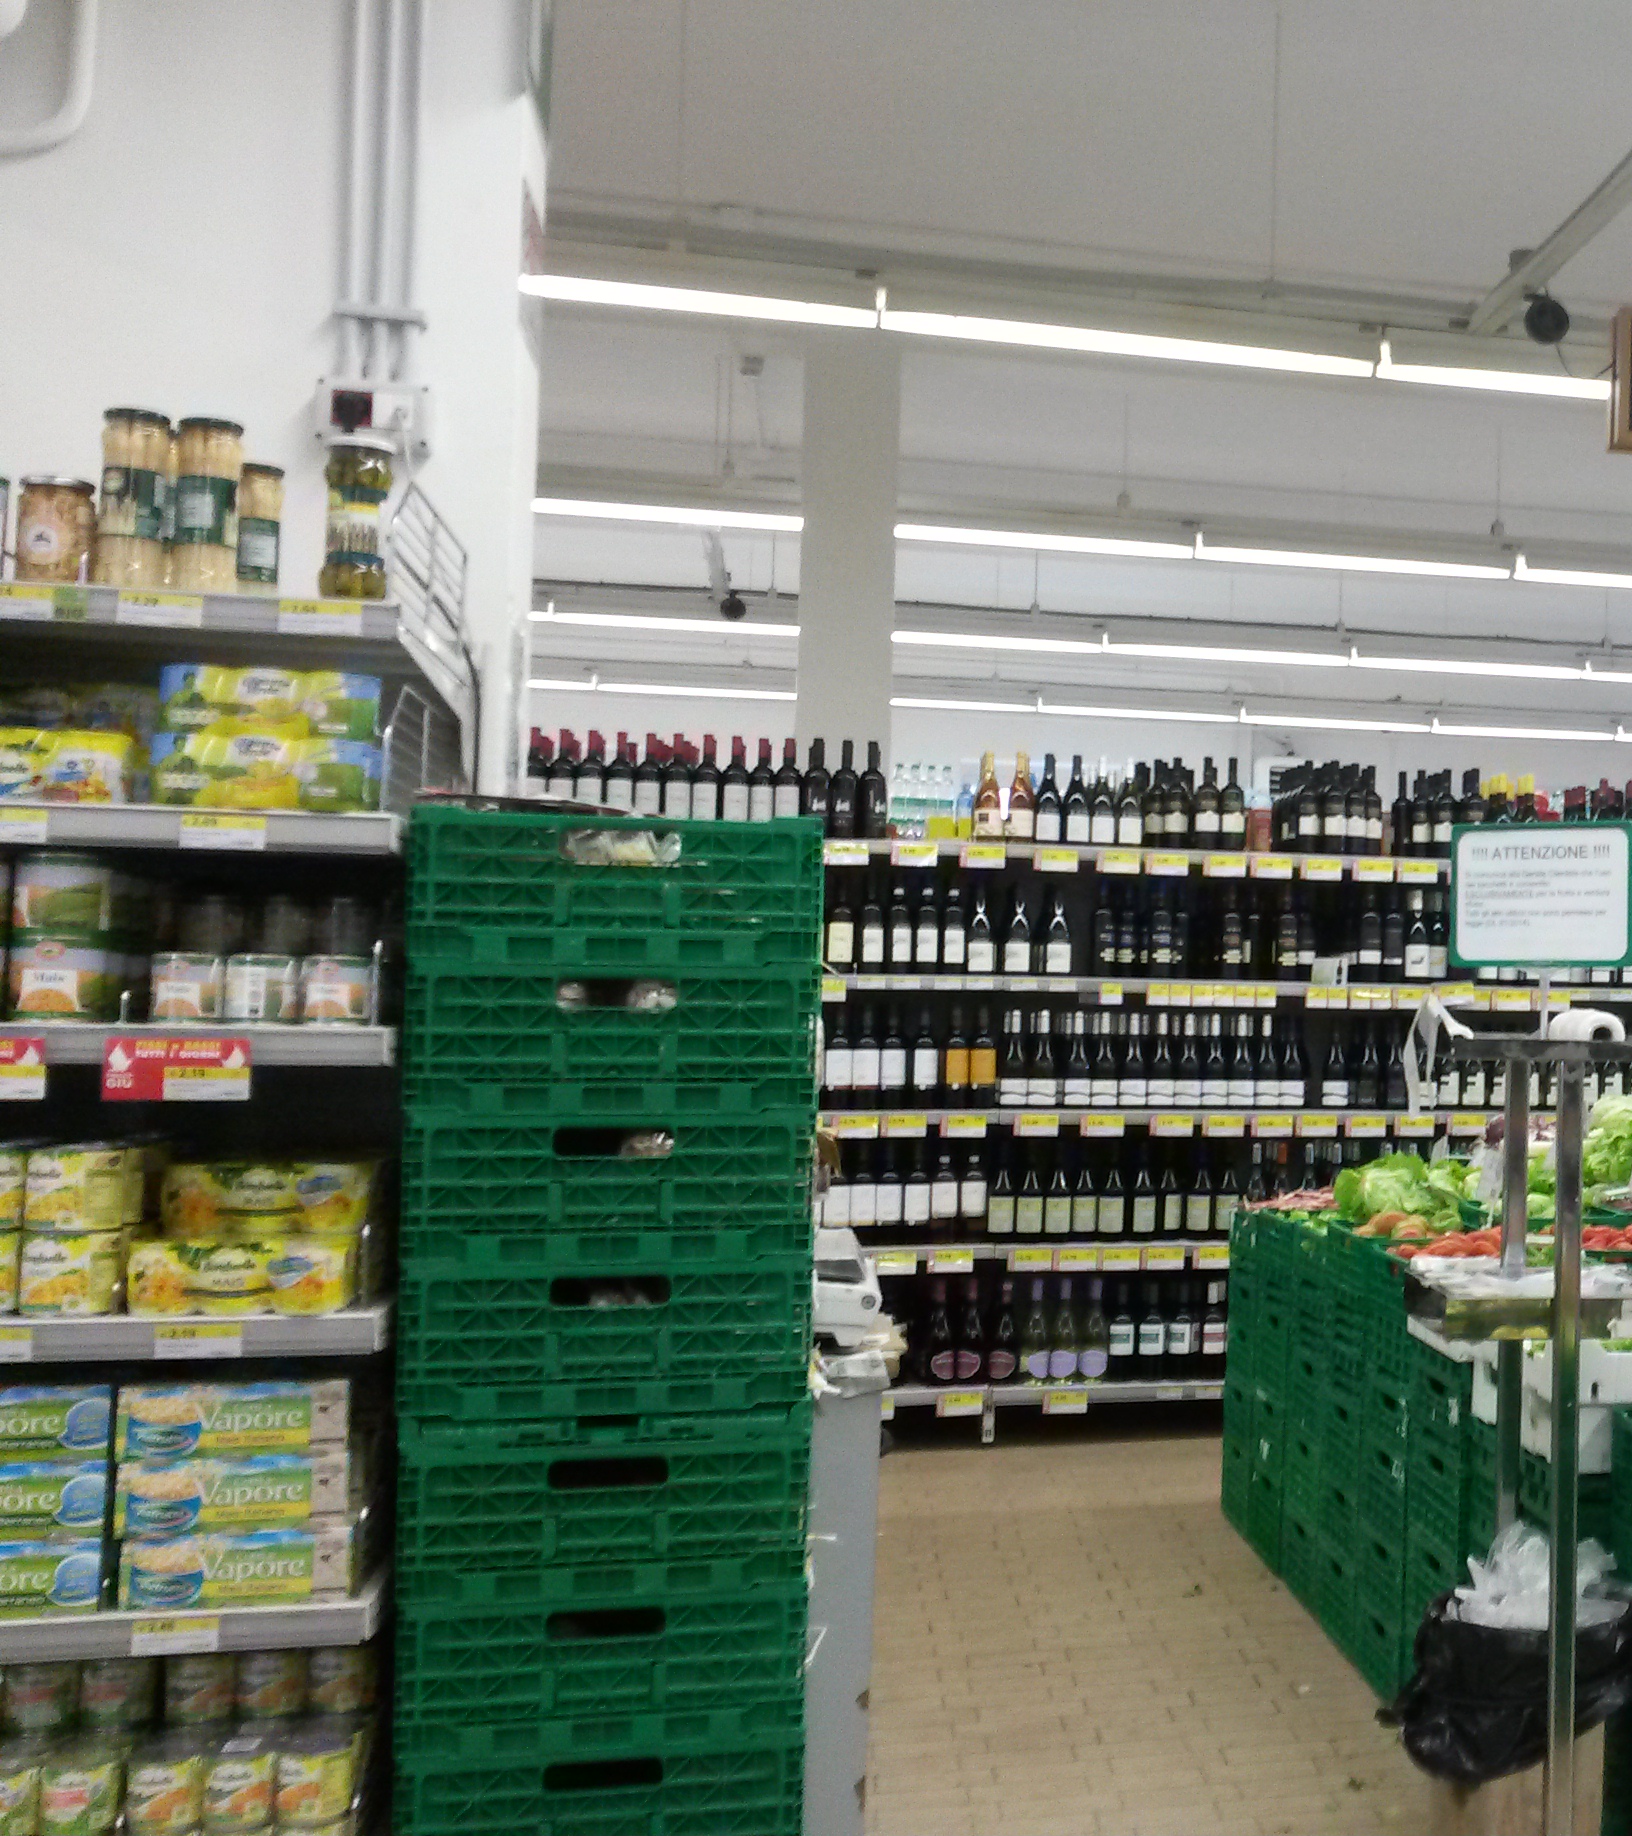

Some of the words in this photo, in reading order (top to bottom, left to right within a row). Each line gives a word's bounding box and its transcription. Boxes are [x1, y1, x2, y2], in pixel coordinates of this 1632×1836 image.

[1491, 845, 1588, 861] ATTENZIONE
[197, 1402, 304, 1433] Vapore
[196, 1476, 304, 1507] Vapore
[199, 1548, 306, 1583] Vapore
